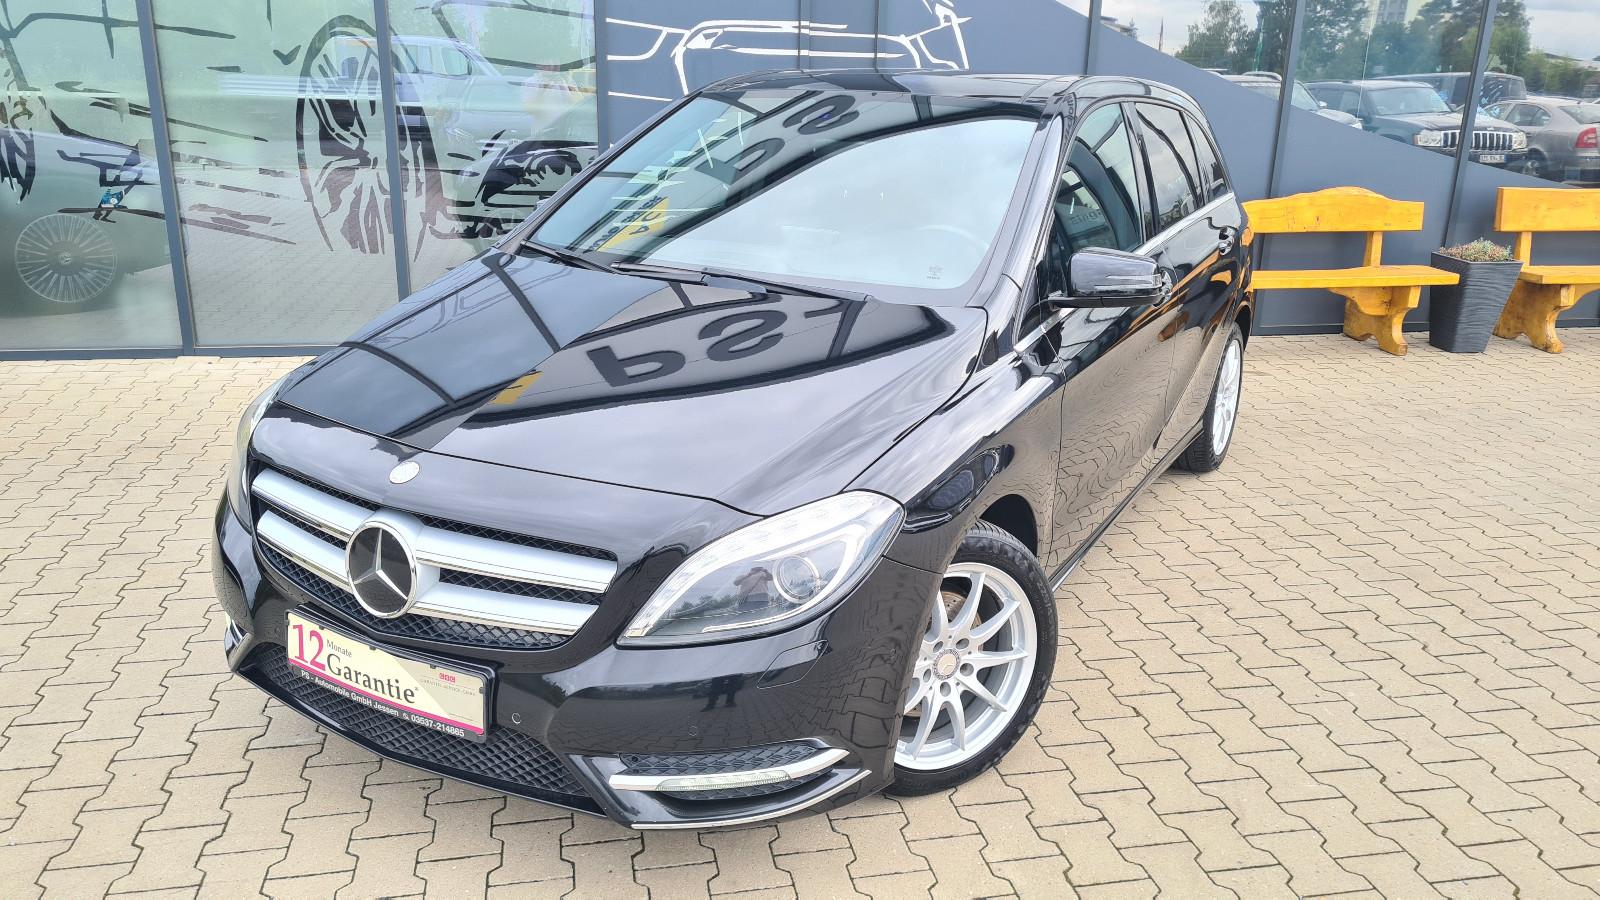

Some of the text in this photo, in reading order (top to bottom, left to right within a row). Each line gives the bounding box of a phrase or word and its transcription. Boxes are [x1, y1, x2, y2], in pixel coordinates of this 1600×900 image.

[293, 624, 326, 671] 12
[327, 639, 352, 657] Monate
[300, 670, 310, 679] PS
[314, 677, 350, 698] Automobile
[351, 693, 373, 708] GmbH
[373, 702, 399, 717] Jessen
